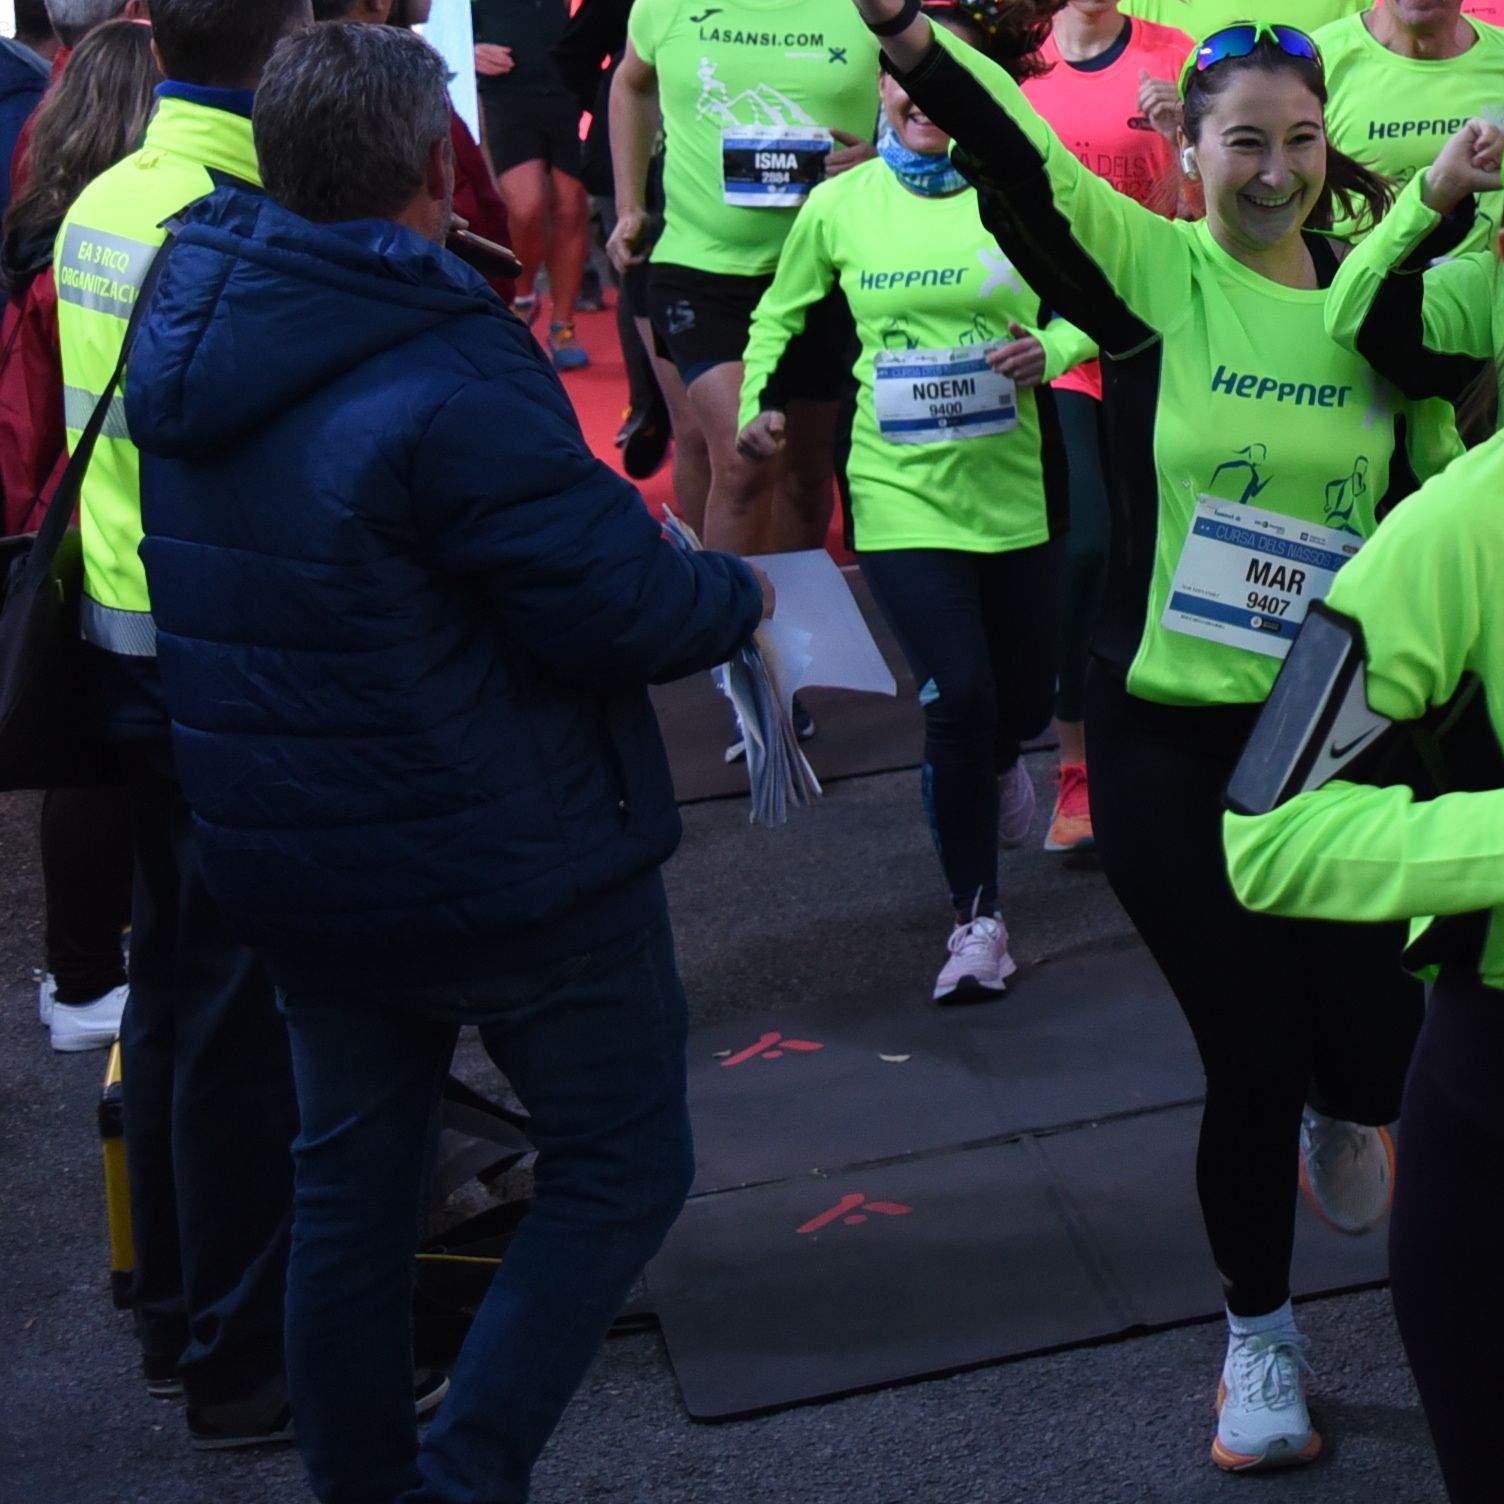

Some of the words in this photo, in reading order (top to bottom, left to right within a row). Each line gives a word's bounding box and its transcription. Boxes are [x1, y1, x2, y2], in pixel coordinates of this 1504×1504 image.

[699, 25, 825, 47] LASANSI.COM
[755, 152, 798, 171] ISMA
[1097, 153, 1147, 178] DELS
[61, 265, 138, 305] ORGANITZACI
[912, 377, 977, 401] NOEMI
[929, 401, 963, 417] 9400
[1216, 523, 1257, 550] CURSA
[1245, 557, 1307, 597] MAR
[1246, 591, 1292, 617] 9407
